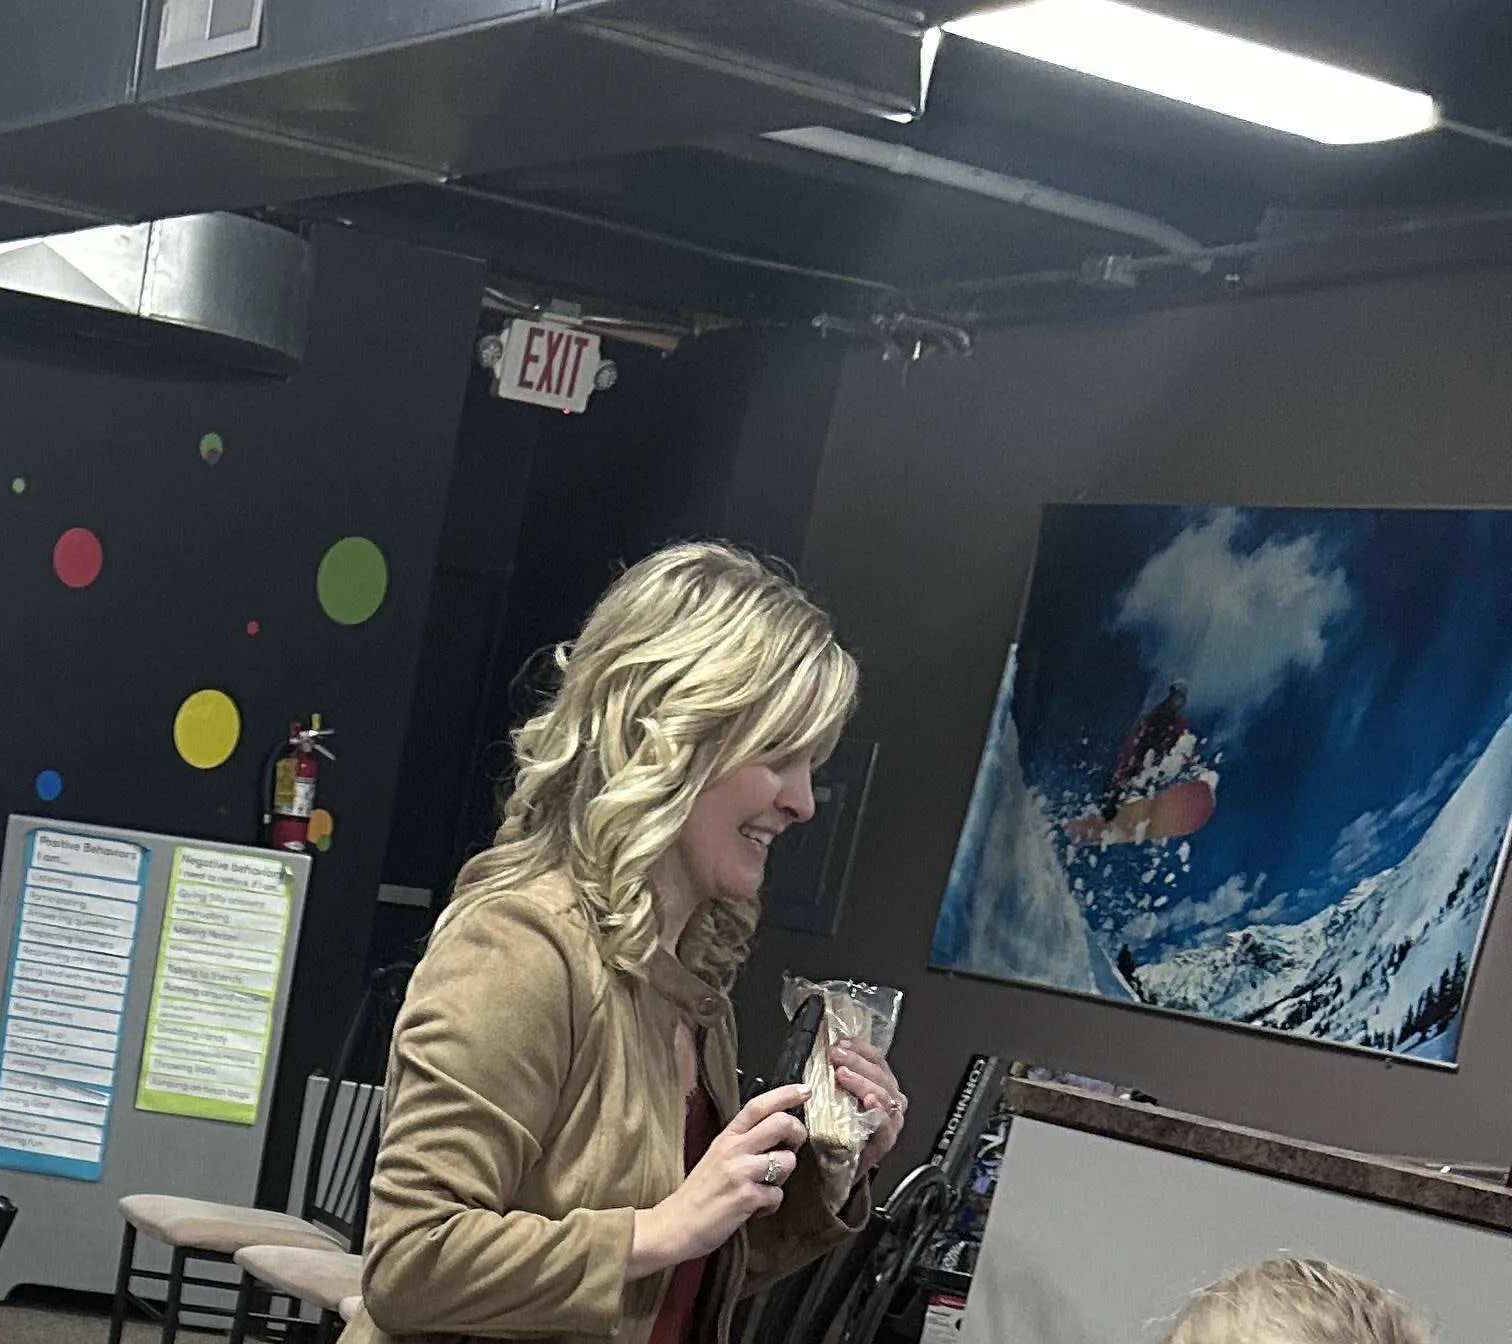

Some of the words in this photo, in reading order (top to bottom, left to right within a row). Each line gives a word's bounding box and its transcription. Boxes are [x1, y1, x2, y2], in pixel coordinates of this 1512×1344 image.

[517, 326, 590, 398] EXIT
[39, 836, 80, 851] Positive
[83, 842, 137, 860] Behaviors
[182, 854, 229, 871] Negative
